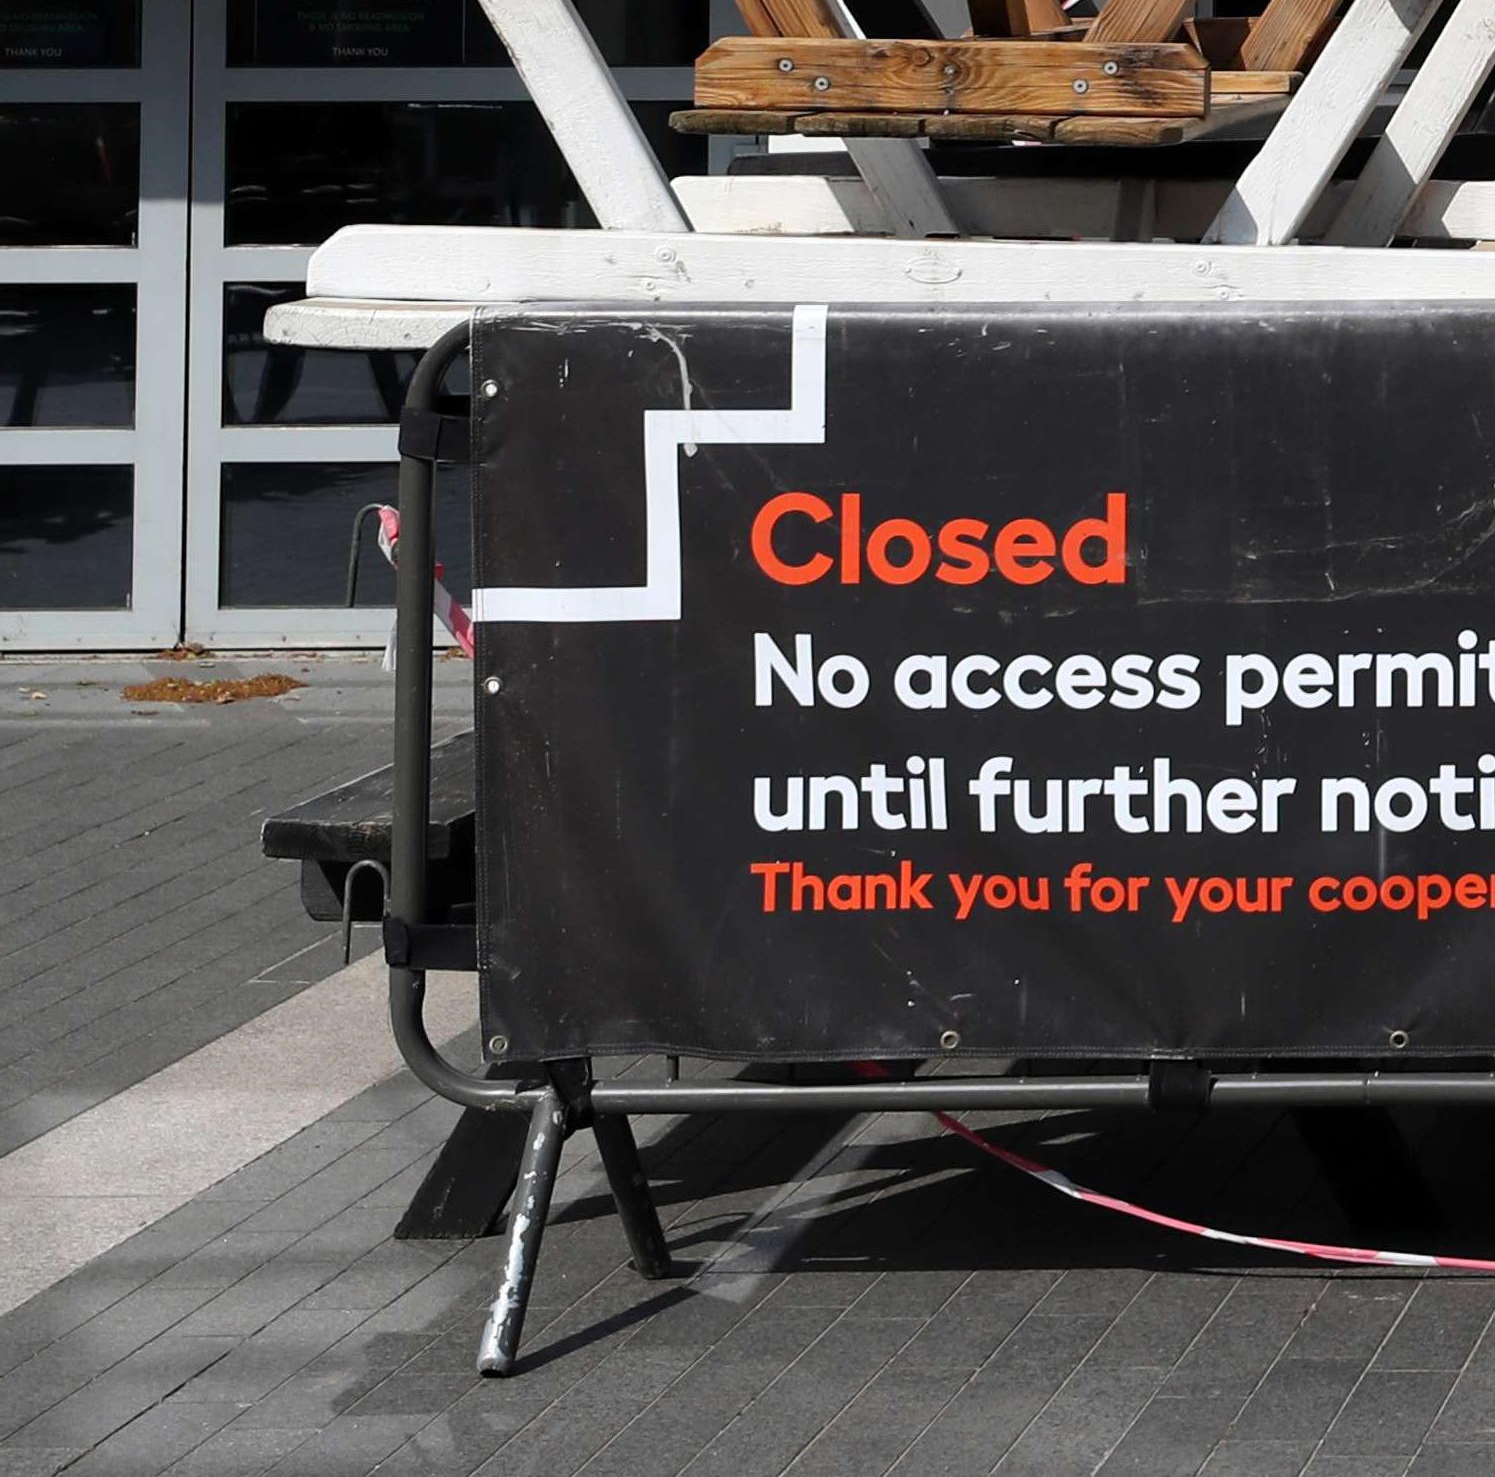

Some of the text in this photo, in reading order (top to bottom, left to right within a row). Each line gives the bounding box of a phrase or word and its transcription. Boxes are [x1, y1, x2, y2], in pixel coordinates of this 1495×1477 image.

[4, 47, 63, 57] THANK YOU
[331, 46, 389, 57] THANK YOU
[750, 491, 1127, 586] Closed
[754, 632, 870, 709] No
[894, 654, 1201, 710] access
[753, 755, 948, 832] until
[968, 756, 1297, 834] further
[750, 860, 933, 913] Thank
[948, 874, 1050, 920] you
[1063, 862, 1151, 913] for
[1163, 876, 1294, 923] your
